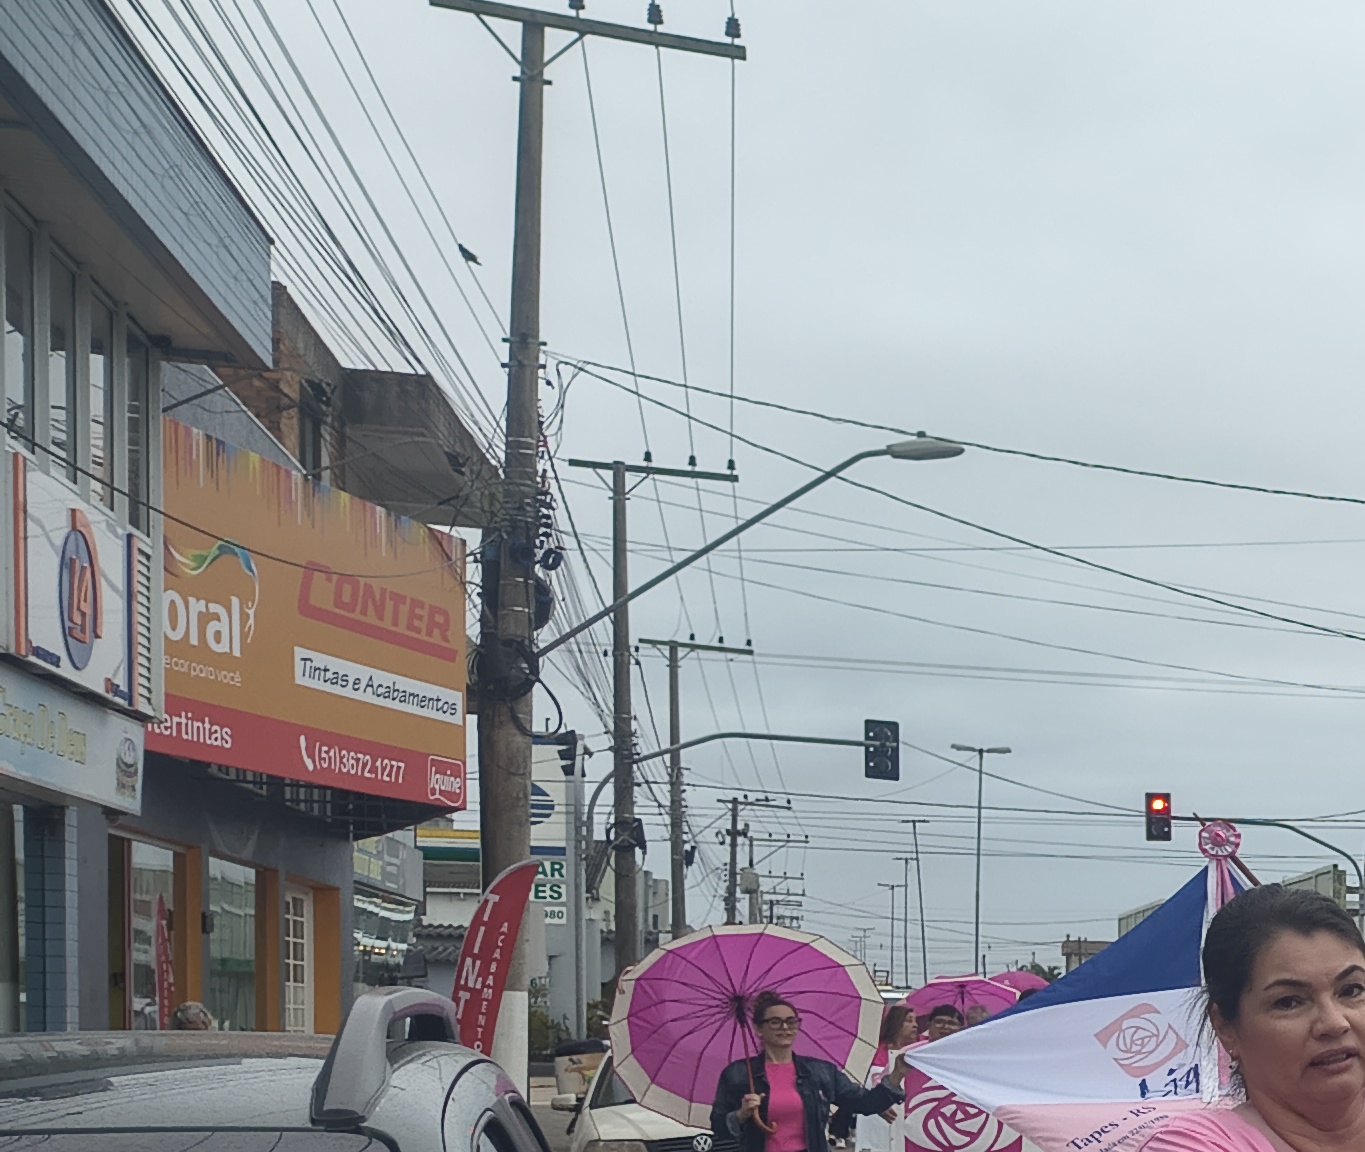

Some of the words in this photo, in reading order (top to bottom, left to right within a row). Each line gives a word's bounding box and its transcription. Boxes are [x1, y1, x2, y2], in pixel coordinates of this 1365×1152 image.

[162, 590, 241, 657] oral
[298, 560, 457, 663] CONTER
[300, 657, 349, 688] Tintas
[352, 677, 361, 691] e
[363, 675, 458, 716] Acabamentos
[315, 742, 405, 784] (51)3672.1277
[430, 767, 461, 796] Iquine
[456, 893, 500, 1019] TINT
[1066, 1119, 1119, 1151] Tapes
[1129, 1104, 1157, 1118] RS
